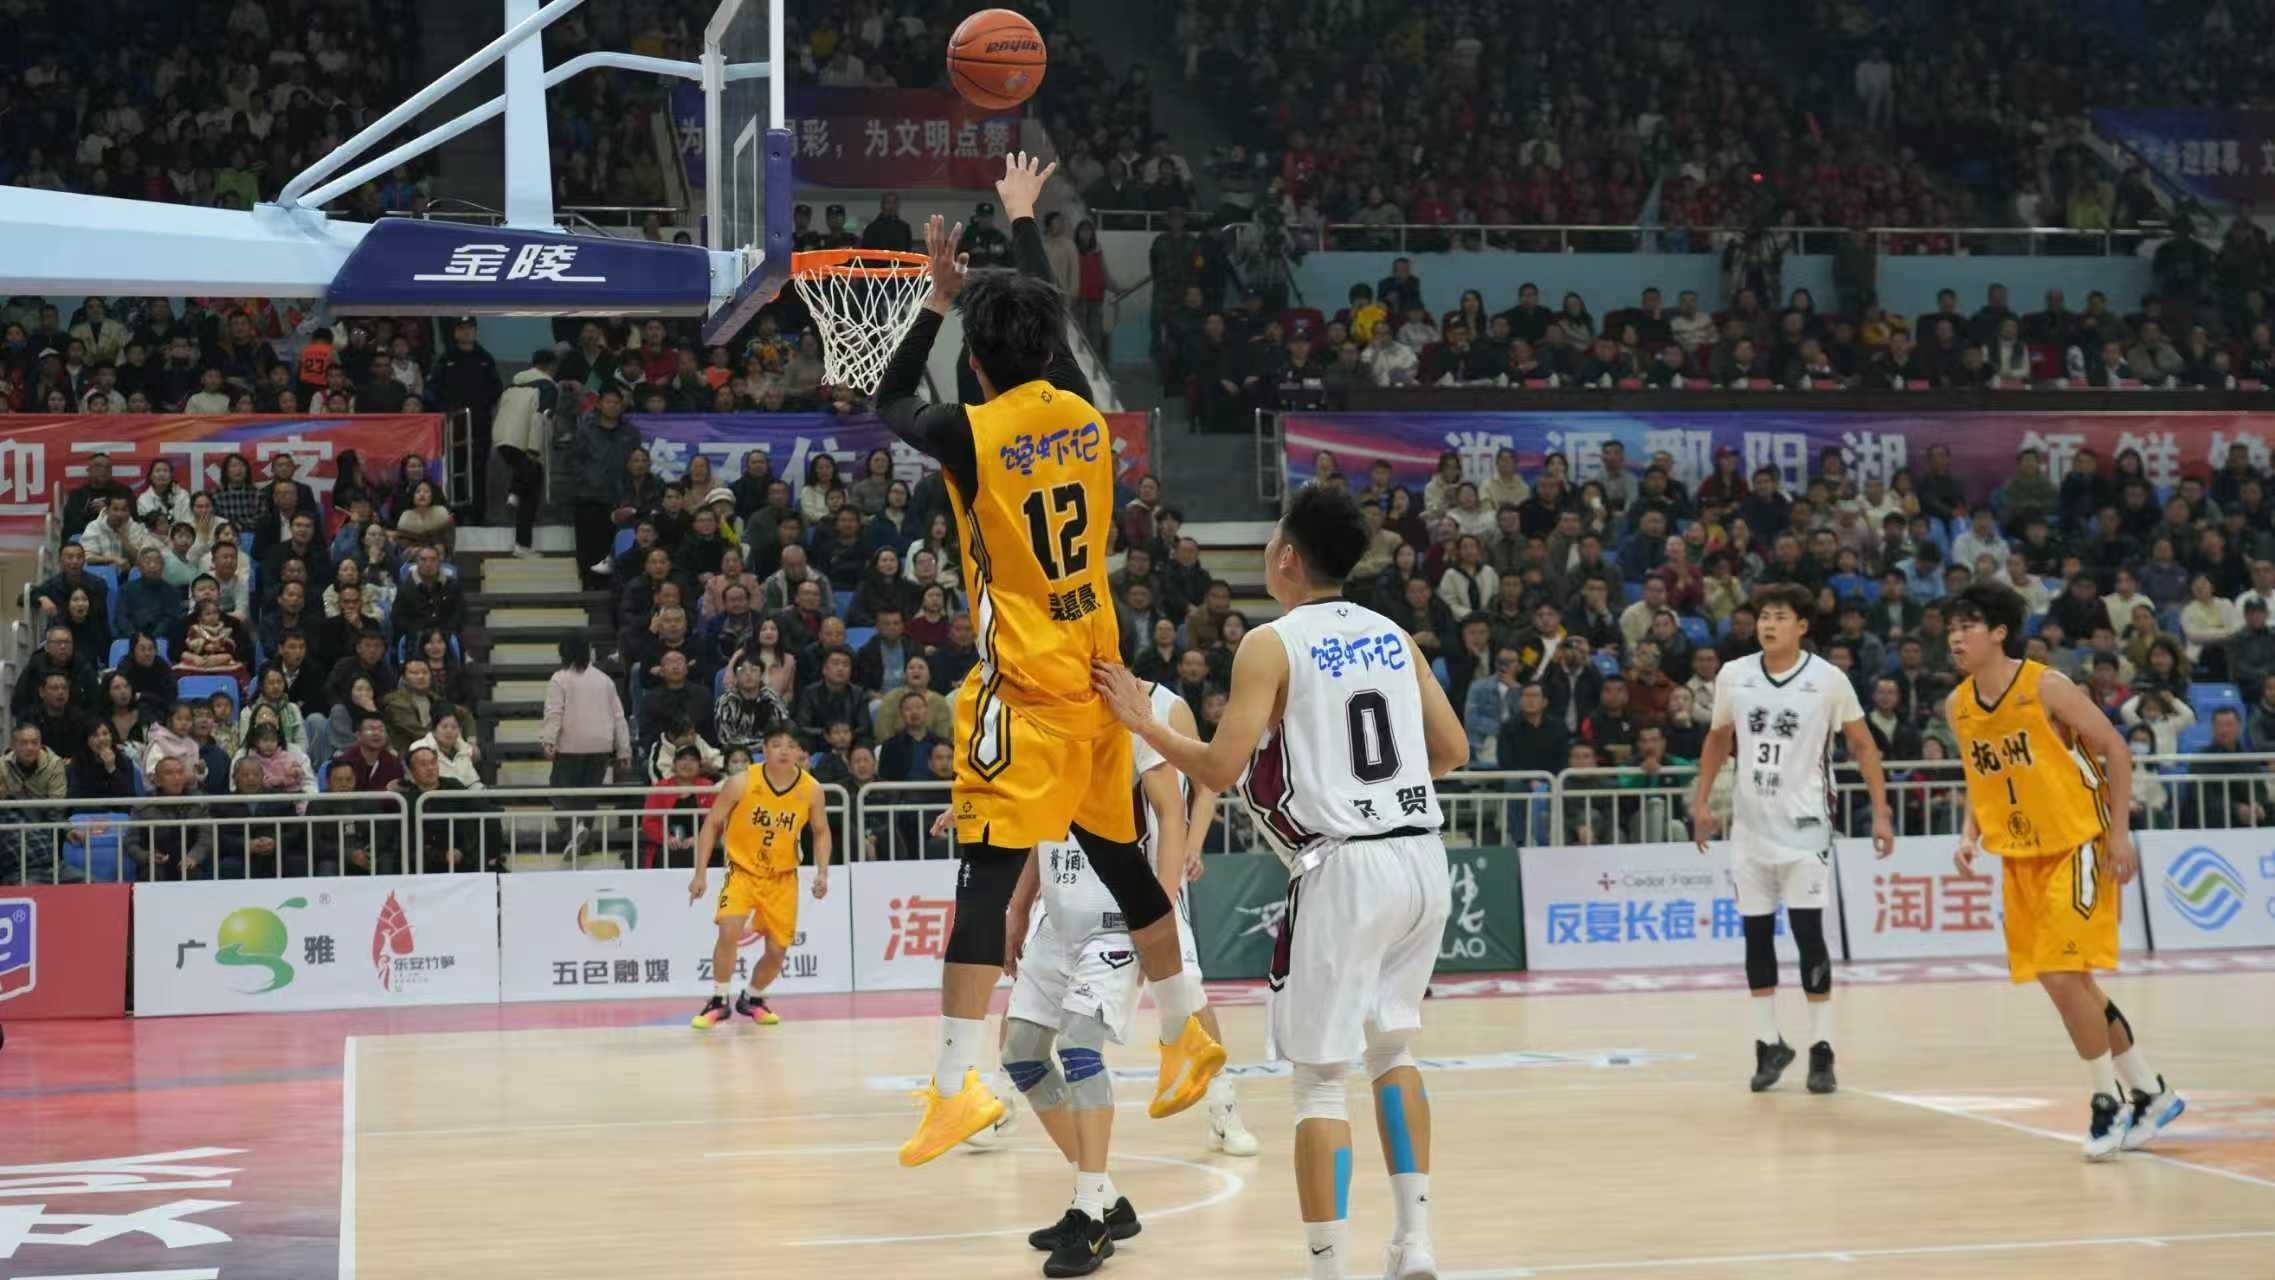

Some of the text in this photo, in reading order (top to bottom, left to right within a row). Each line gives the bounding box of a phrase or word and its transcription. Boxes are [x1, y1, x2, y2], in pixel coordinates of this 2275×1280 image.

[413, 244, 606, 282] 金陵
[1021, 480, 1088, 581] 12
[1345, 688, 1402, 785] 0
[1757, 743, 1781, 765] 31
[2006, 776, 2017, 805] 1
[762, 830, 774, 847] 2
[1874, 873, 1994, 933] 淘宝
[884, 897, 955, 961] 淘
[552, 958, 670, 985] 五色融媒
